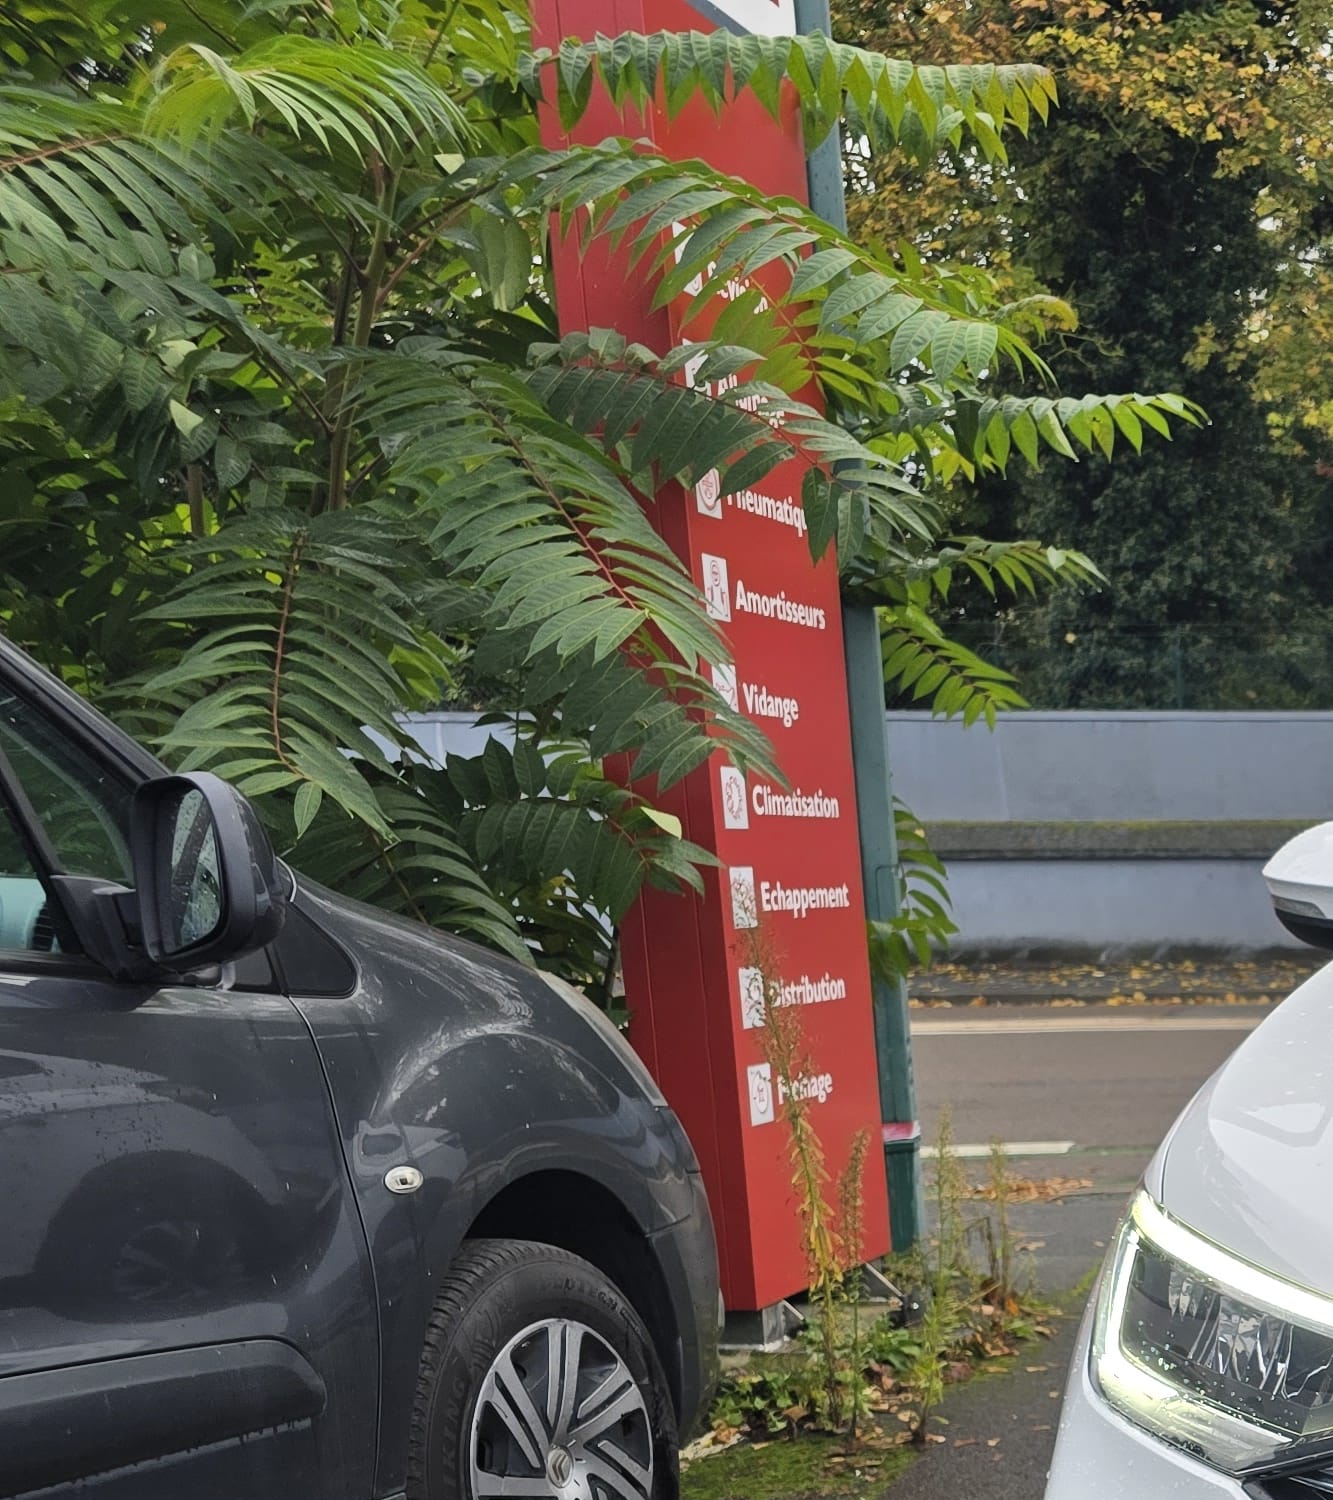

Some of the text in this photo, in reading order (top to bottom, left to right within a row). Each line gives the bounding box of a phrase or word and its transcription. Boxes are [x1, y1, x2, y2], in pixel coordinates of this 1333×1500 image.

[726, 489, 808, 538] neumatiqu
[735, 580, 826, 630] Amortisseurs
[742, 683, 800, 728] Vidange
[752, 784, 840, 819] Climatisation
[760, 880, 850, 919] Echappement
